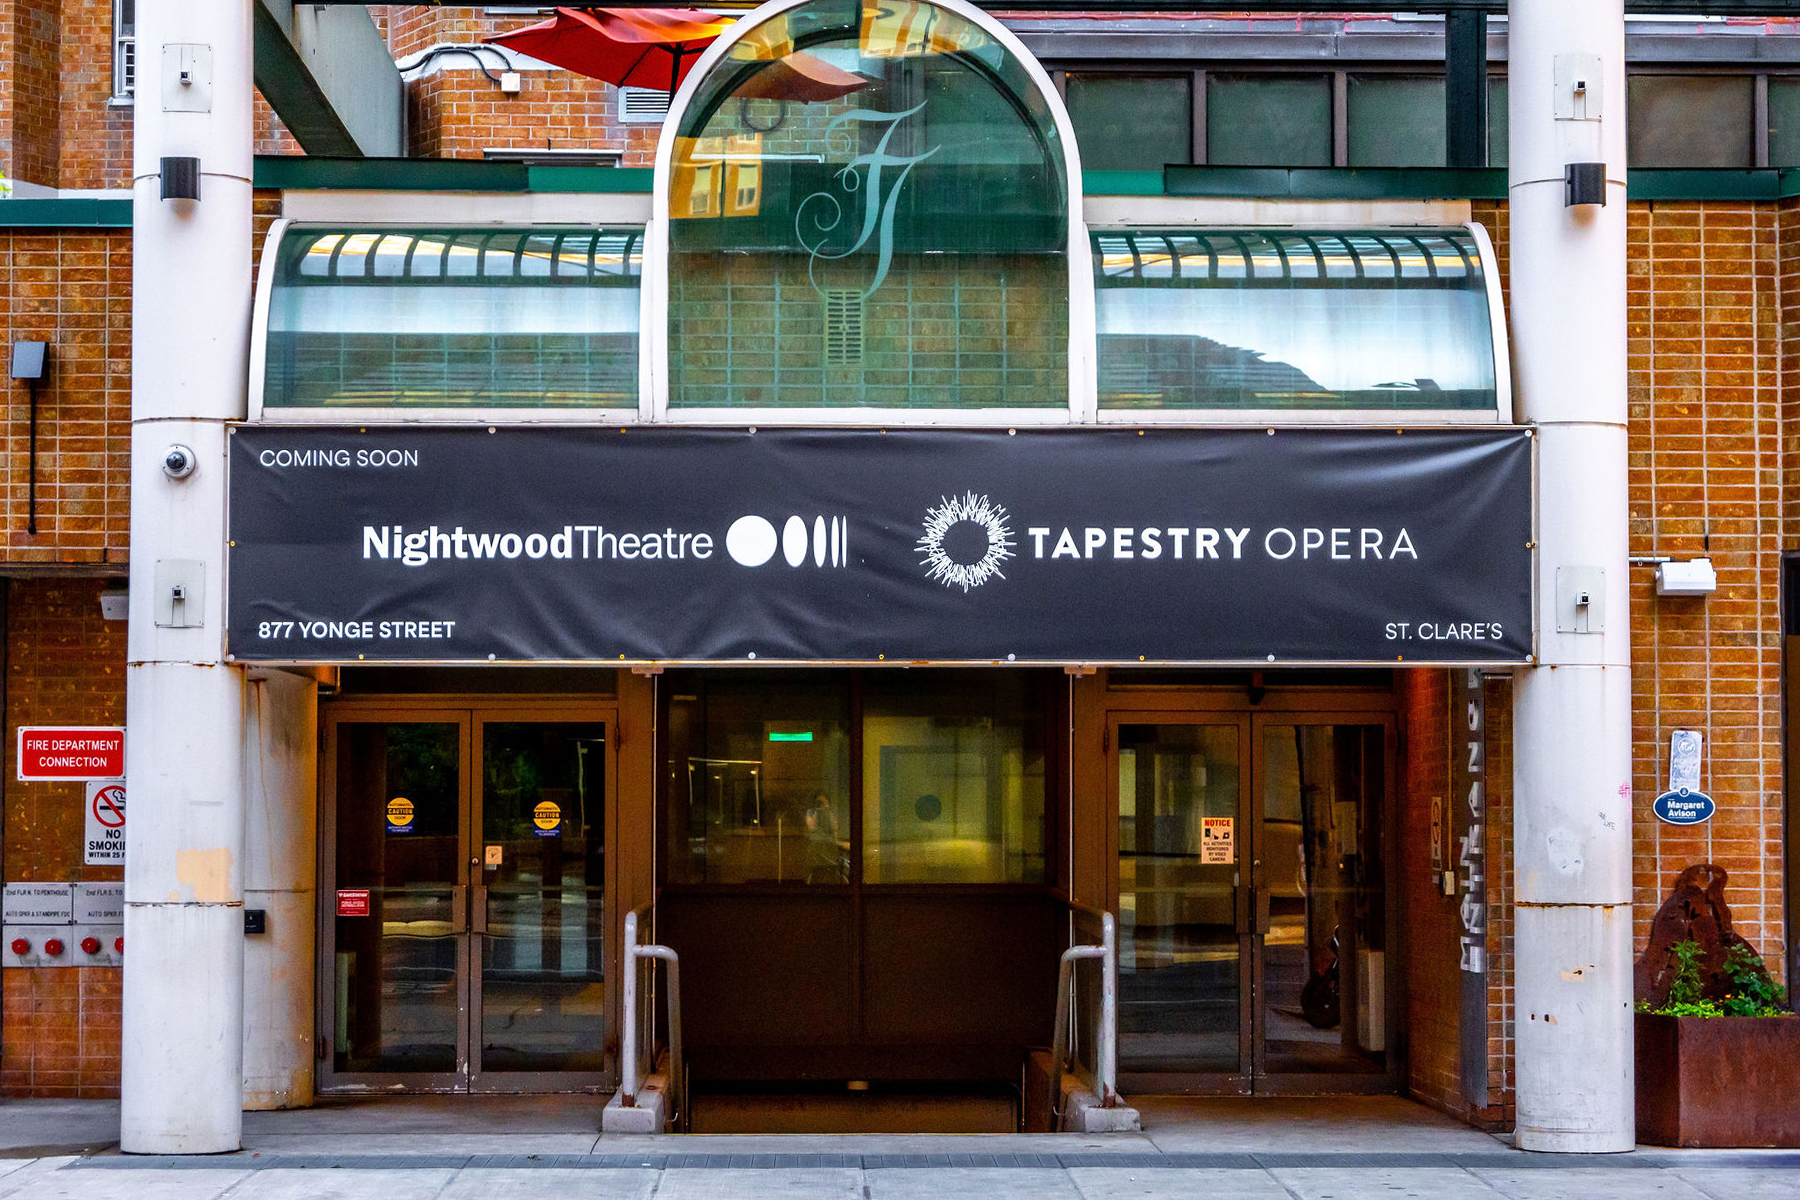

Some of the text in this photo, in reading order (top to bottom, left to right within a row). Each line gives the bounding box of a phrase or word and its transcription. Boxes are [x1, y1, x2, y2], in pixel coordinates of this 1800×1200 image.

[259, 449, 418, 467] COMING SOON
[362, 525, 713, 567] NightwoodTheatre
[1028, 526, 1418, 560] TAPESTRY OPERA
[258, 621, 456, 639] 877 YONGE STREET
[1385, 622, 1503, 640] ST. CLARE'S
[26, 739, 120, 751] FIRE DEPARTMENT
[39, 756, 107, 767] CONNECTION
[1667, 801, 1705, 810] Margaret
[1667, 809, 1697, 817] Avison
[1204, 819, 1231, 827] NOTICE
[106, 829, 121, 839] NO
[89, 841, 125, 850] SMOKI
